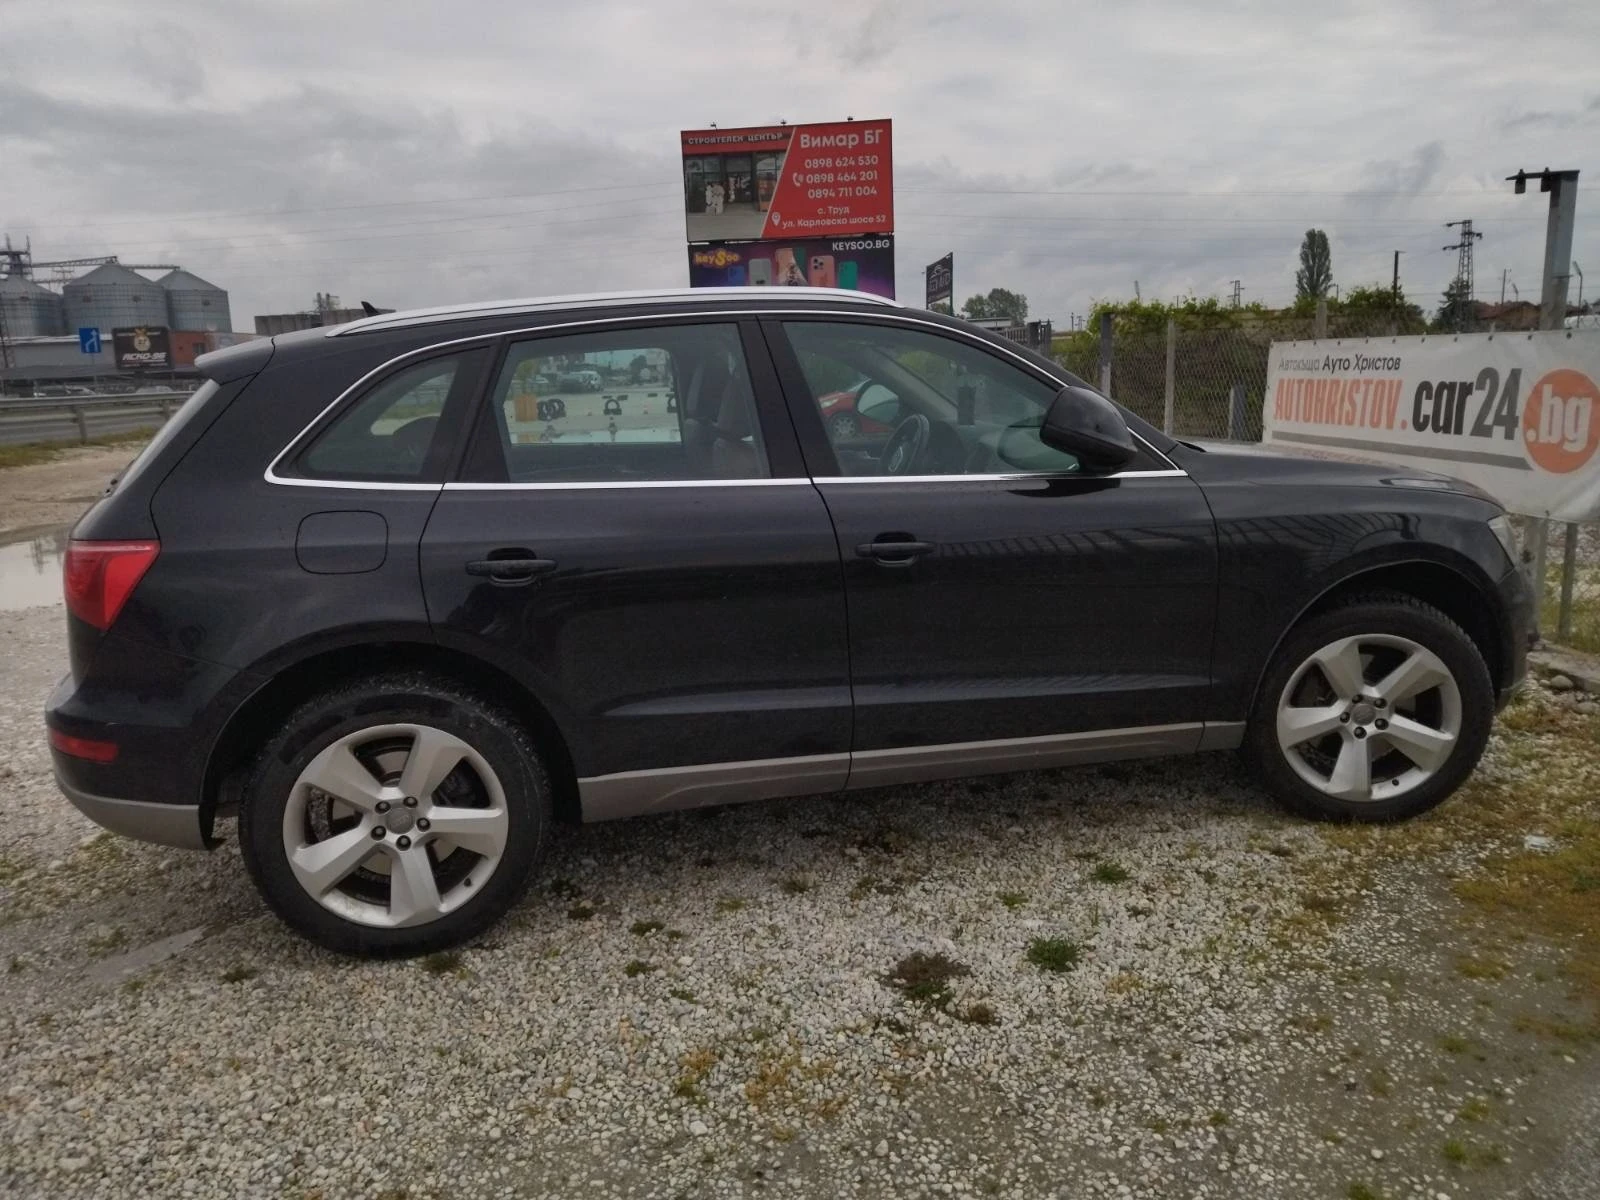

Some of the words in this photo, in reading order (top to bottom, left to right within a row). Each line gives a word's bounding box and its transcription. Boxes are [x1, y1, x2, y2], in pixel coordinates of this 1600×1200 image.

[748, 132, 783, 142] ЦЕНТЪР
[800, 133, 859, 149] Вимар
[864, 128, 884, 145] БГ
[804, 157, 833, 169] 0898
[835, 156, 856, 167] 624
[858, 154, 879, 166] 530
[806, 172, 834, 184] 0898
[837, 171, 857, 182] 464
[859, 170, 878, 181] 201
[807, 187, 836, 199] 0894
[838, 186, 853, 197] 711
[855, 185, 877, 197] 004
[828, 206, 850, 215] Труд
[782, 219, 795, 229] ул.
[797, 217, 848, 228] Карловско
[849, 216, 874, 224] шосе
[832, 240, 890, 251] KEYSOO.BG
[1322, 354, 1351, 374] Ауто
[1353, 353, 1402, 374] Христов
